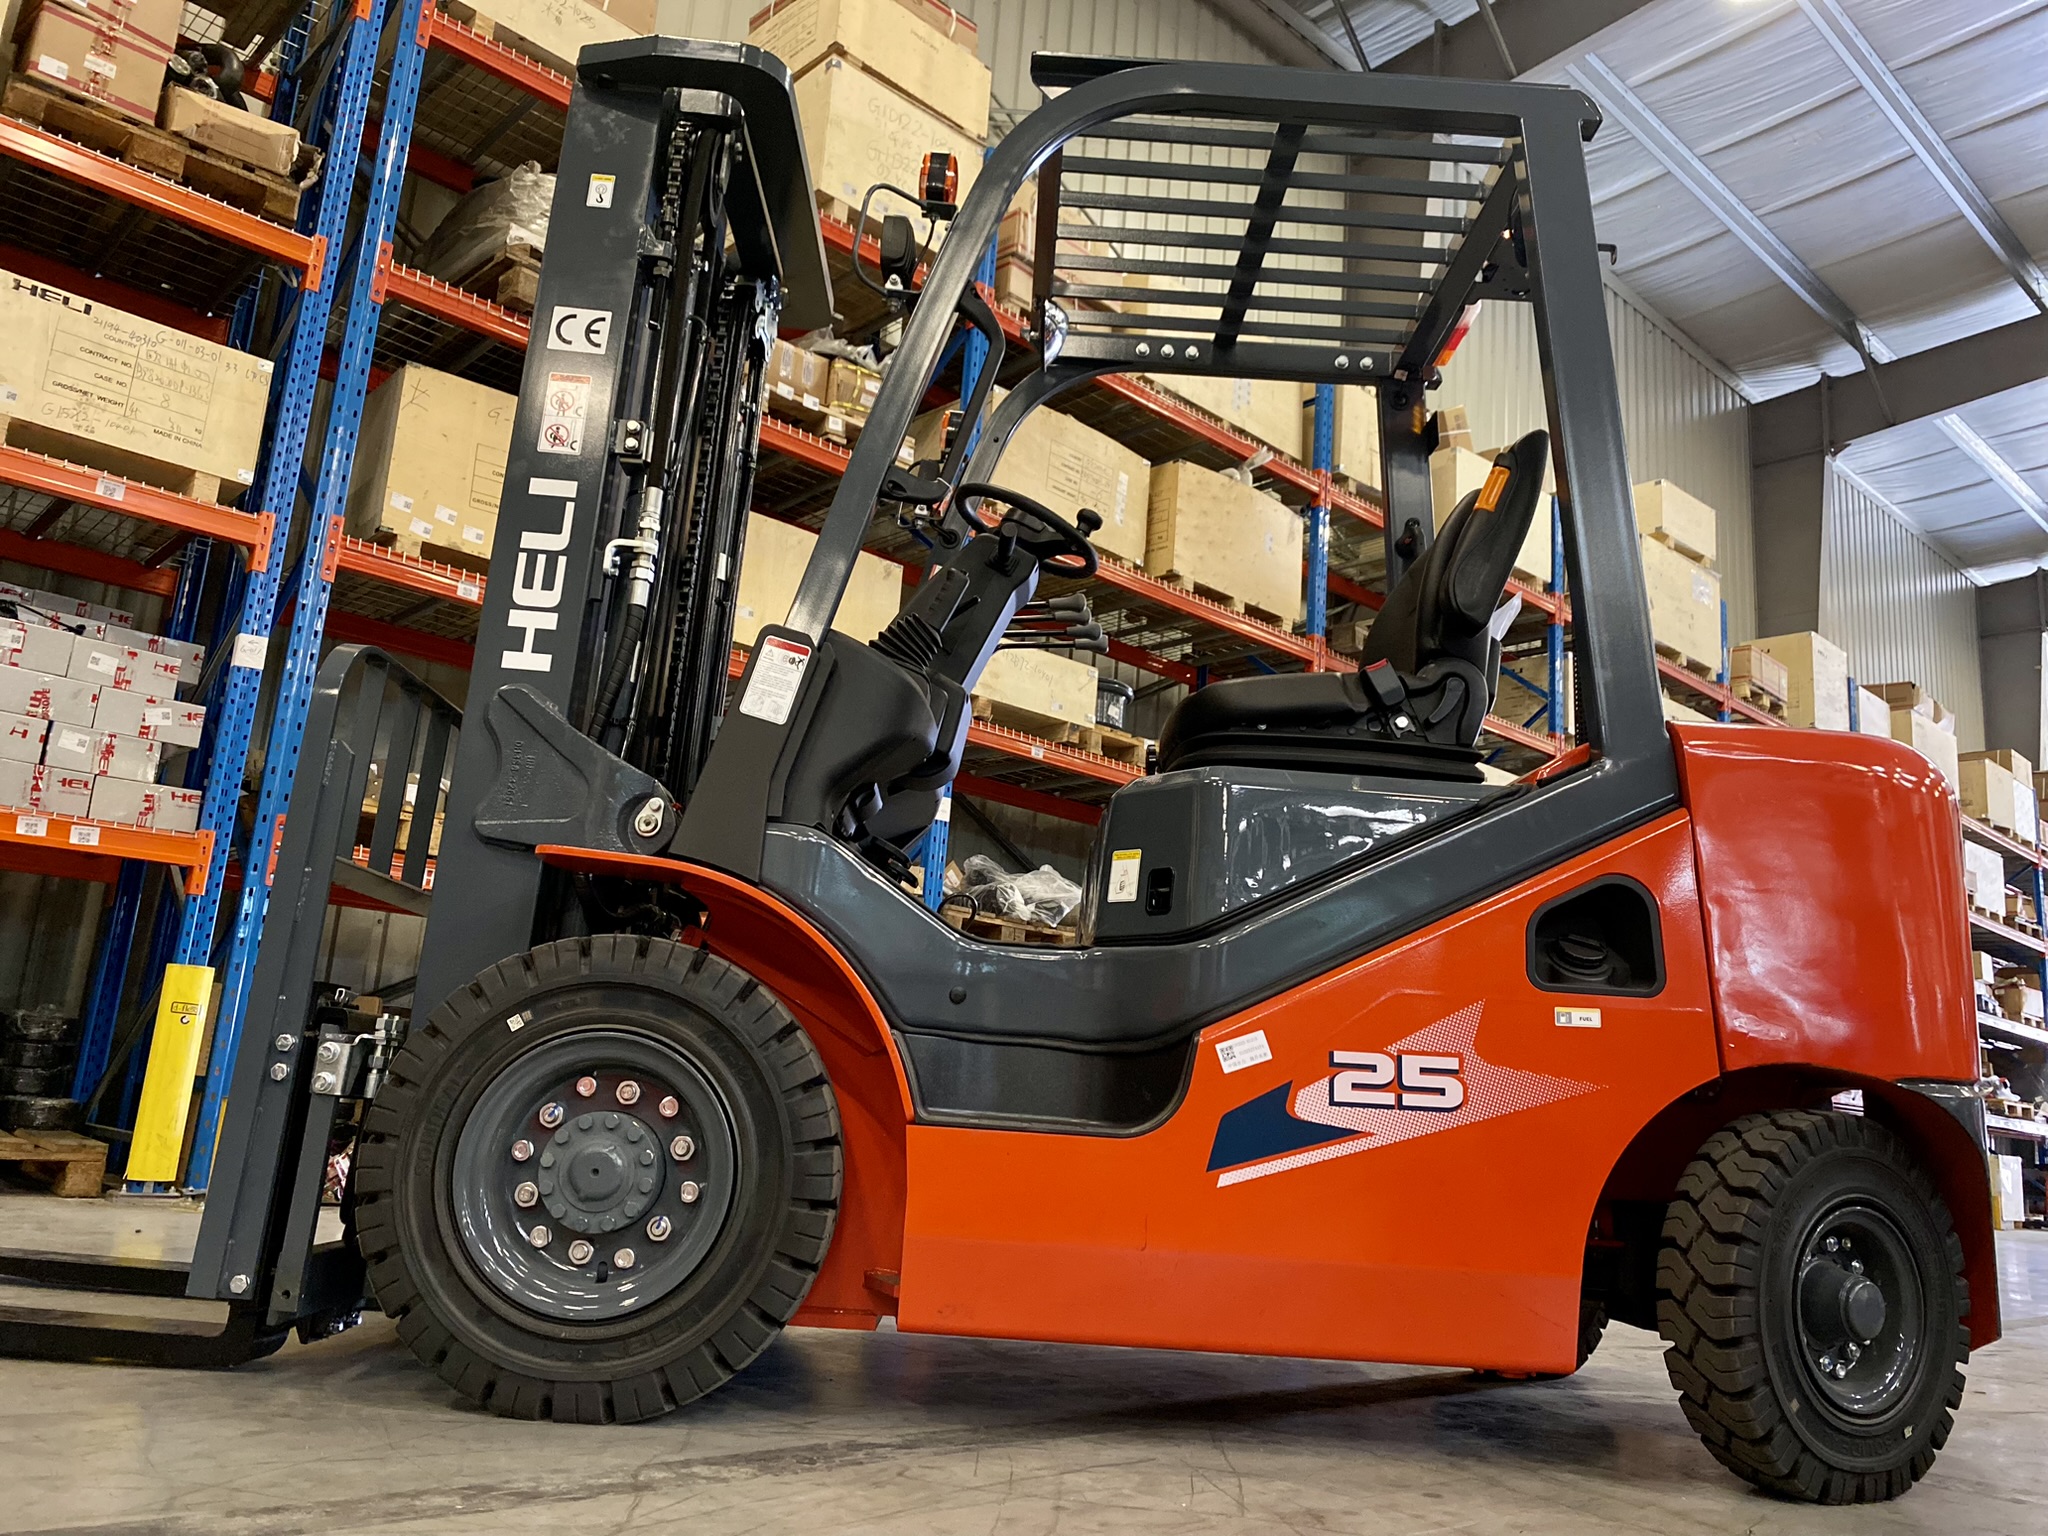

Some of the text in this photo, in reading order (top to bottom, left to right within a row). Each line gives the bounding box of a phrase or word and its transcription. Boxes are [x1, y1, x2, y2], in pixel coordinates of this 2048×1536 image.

[12, 278, 92, 316] HELI
[103, 333, 138, 349] COUNTRY
[555, 314, 606, 349] CE
[79, 346, 119, 364] CONTRACT
[93, 372, 114, 384] CASE
[96, 394, 125, 408] WEIGHT
[153, 428, 173, 440] MADE
[181, 437, 203, 449] CHINA
[501, 477, 578, 672] HELI
[1329, 1050, 1464, 1113] 25
